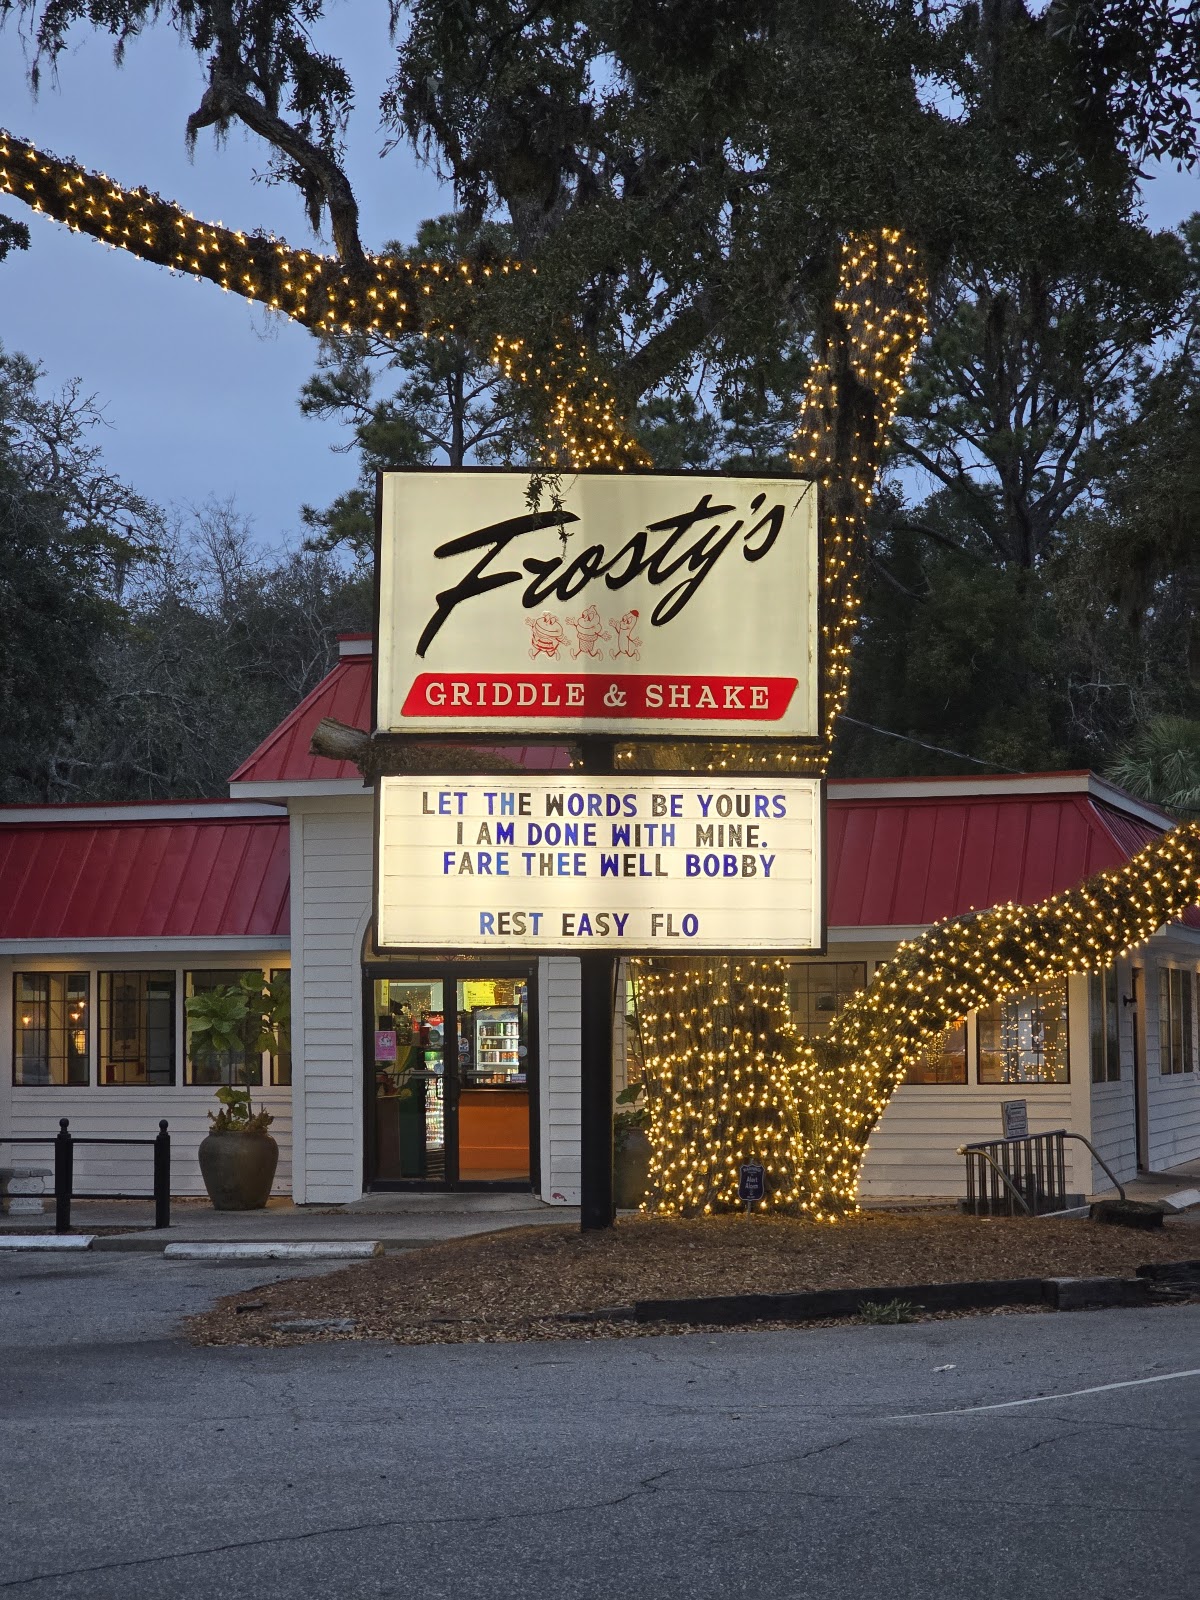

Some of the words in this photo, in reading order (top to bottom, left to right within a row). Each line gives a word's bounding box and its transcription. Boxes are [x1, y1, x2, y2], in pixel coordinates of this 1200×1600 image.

[415, 492, 786, 660] Frosty's
[426, 683, 585, 706] GRIDDLE
[604, 684, 627, 707] &
[646, 684, 769, 709] SHAKE
[423, 792, 467, 815] LET
[484, 793, 531, 816] THE
[546, 793, 637, 817] WORDS
[652, 794, 683, 817] BE
[697, 795, 786, 818] YOURS
[456, 822, 463, 845] I
[477, 822, 514, 846] AM
[528, 823, 596, 847] DONE
[612, 824, 675, 847] WITH
[696, 825, 767, 848] MINE.
[443, 852, 509, 875] FARE
[522, 853, 586, 876] THEE
[601, 854, 668, 877] WELL
[686, 854, 775, 878] BOBBY
[480, 911, 543, 935] REST
[562, 913, 629, 936] EASY
[652, 914, 698, 937] FLO
